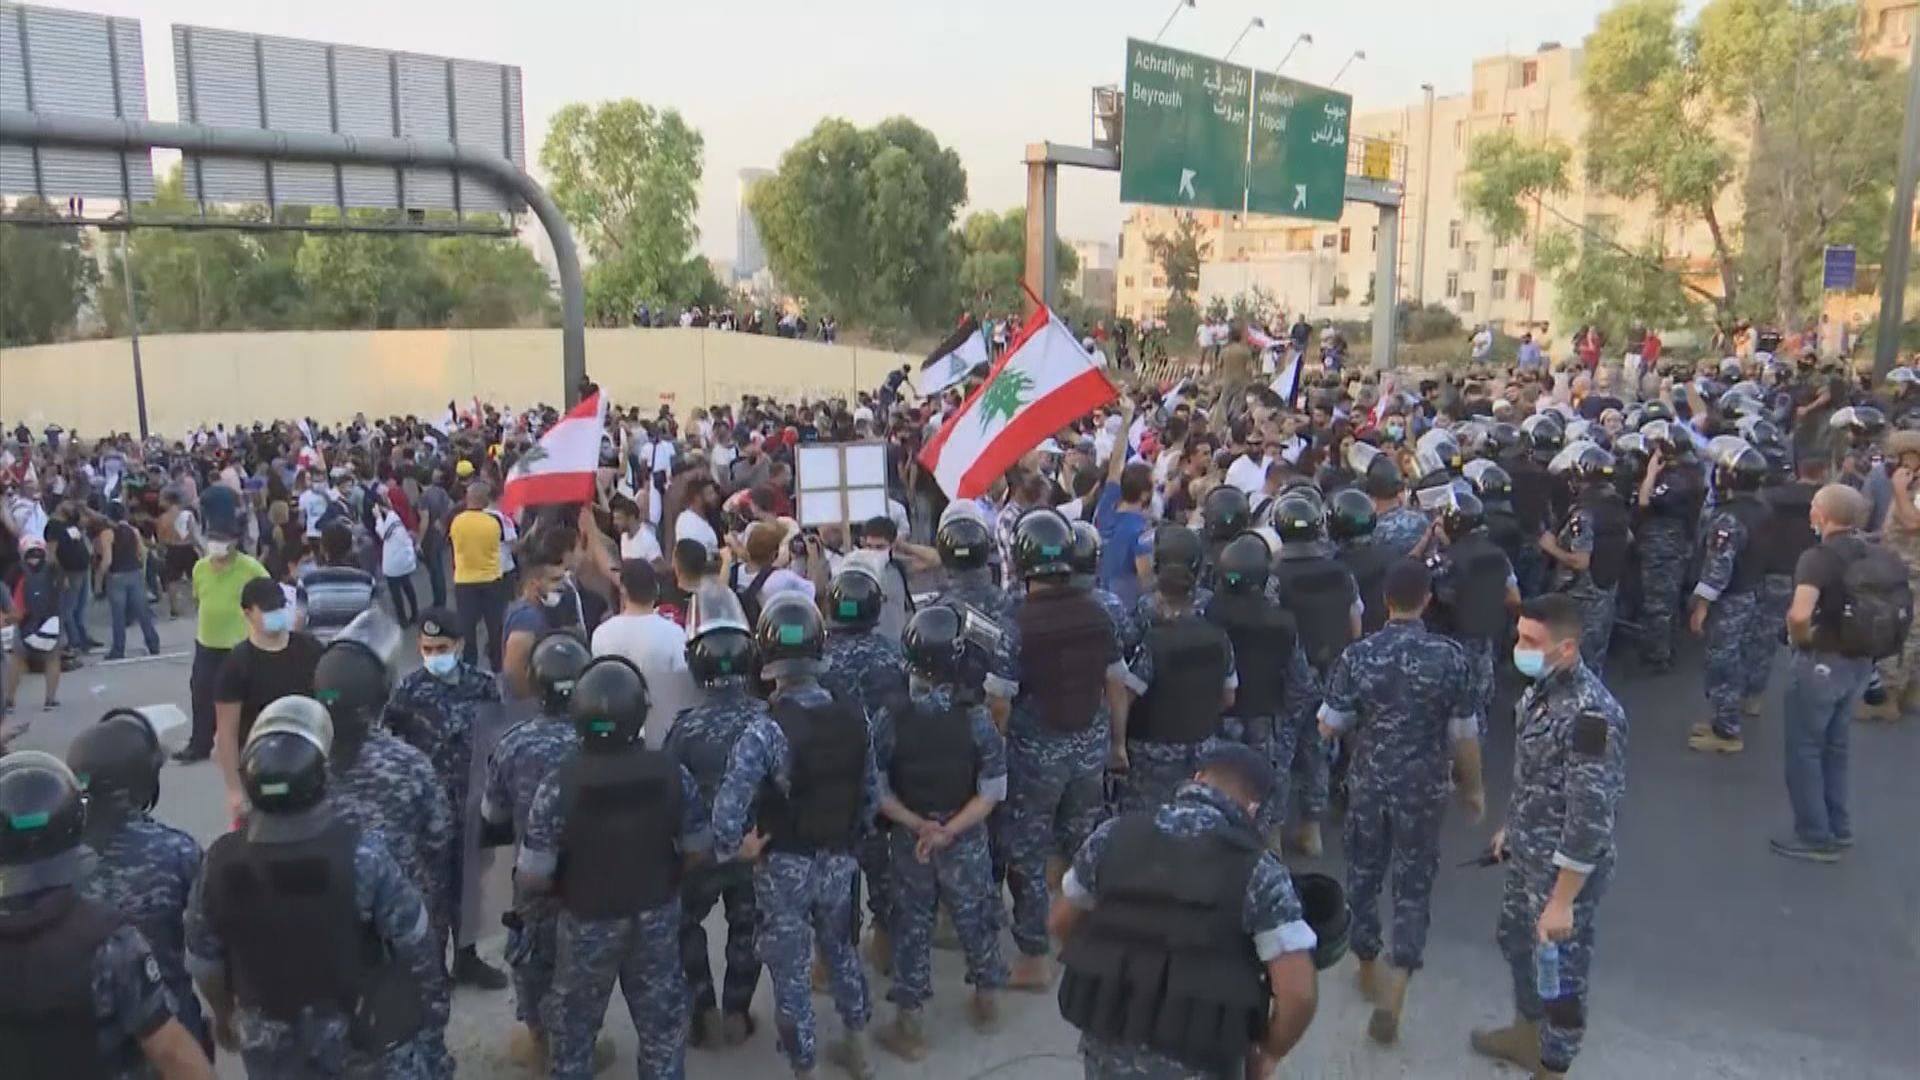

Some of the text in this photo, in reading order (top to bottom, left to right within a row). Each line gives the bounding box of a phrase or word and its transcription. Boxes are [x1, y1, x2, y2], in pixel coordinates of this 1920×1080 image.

[1135, 51, 1194, 80] Achrafiyeh
[1133, 82, 1182, 108] Beyrouth
[1213, 100, 1245, 125] بيروت
[1311, 124, 1345, 147] طرابلس
